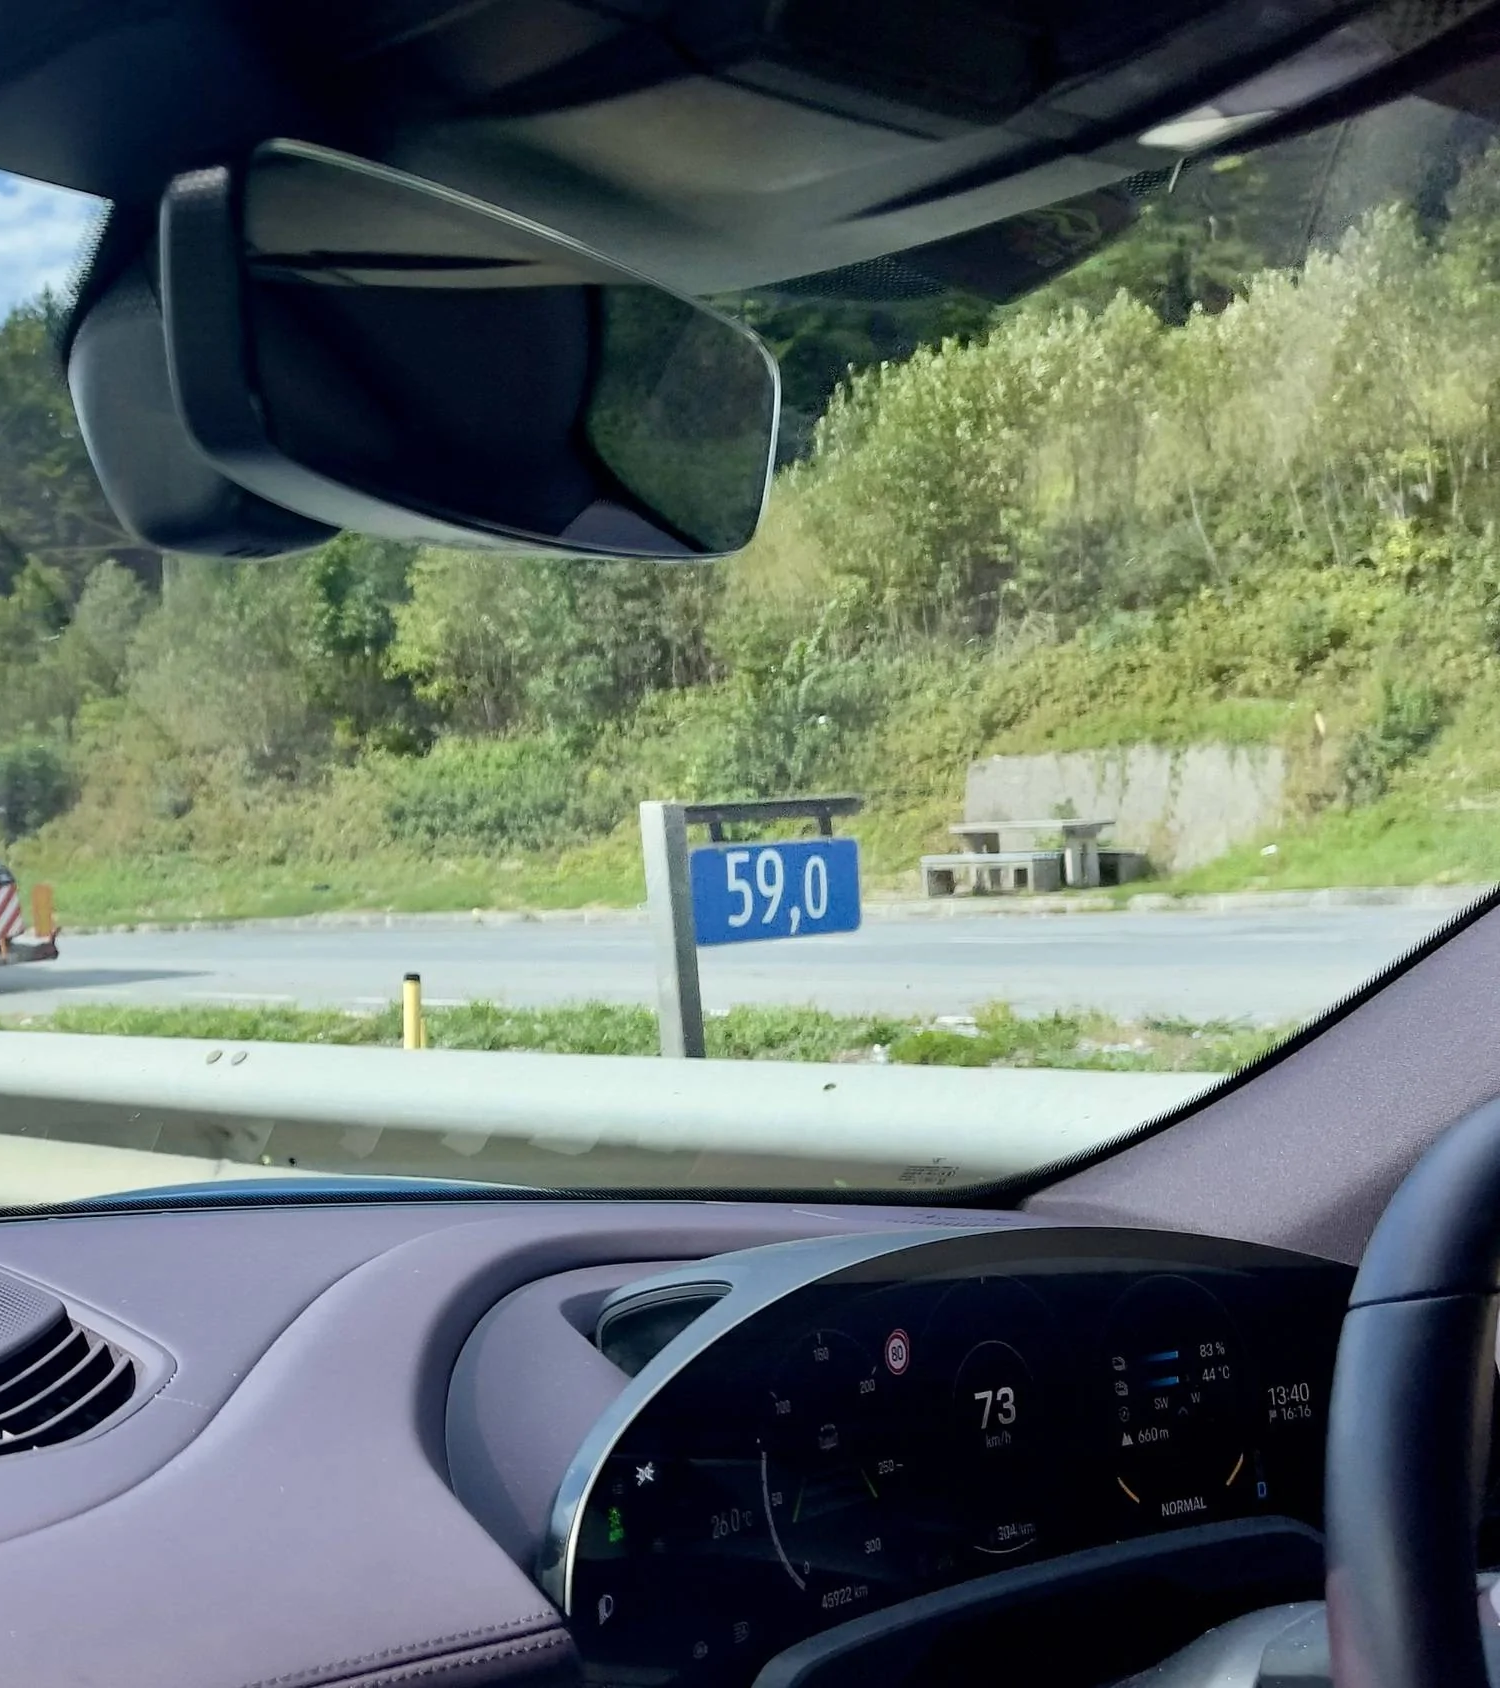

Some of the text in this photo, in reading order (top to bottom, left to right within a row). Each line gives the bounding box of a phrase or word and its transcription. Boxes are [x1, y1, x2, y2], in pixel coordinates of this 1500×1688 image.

[726, 849, 828, 935] 59,0
[891, 1344, 904, 1362] 80
[1199, 1343, 1214, 1358] 83
[1153, 1396, 1169, 1410] SW
[1267, 1382, 1311, 1406] 13:40
[973, 1386, 1017, 1430] 73
[1280, 1404, 1312, 1421] 16:16
[1138, 1426, 1158, 1444] 660
[877, 1458, 895, 1475] 250
[1161, 1496, 1208, 1517] NORMAL
[864, 1536, 882, 1555] 300
[820, 1586, 853, 1610] 45922
